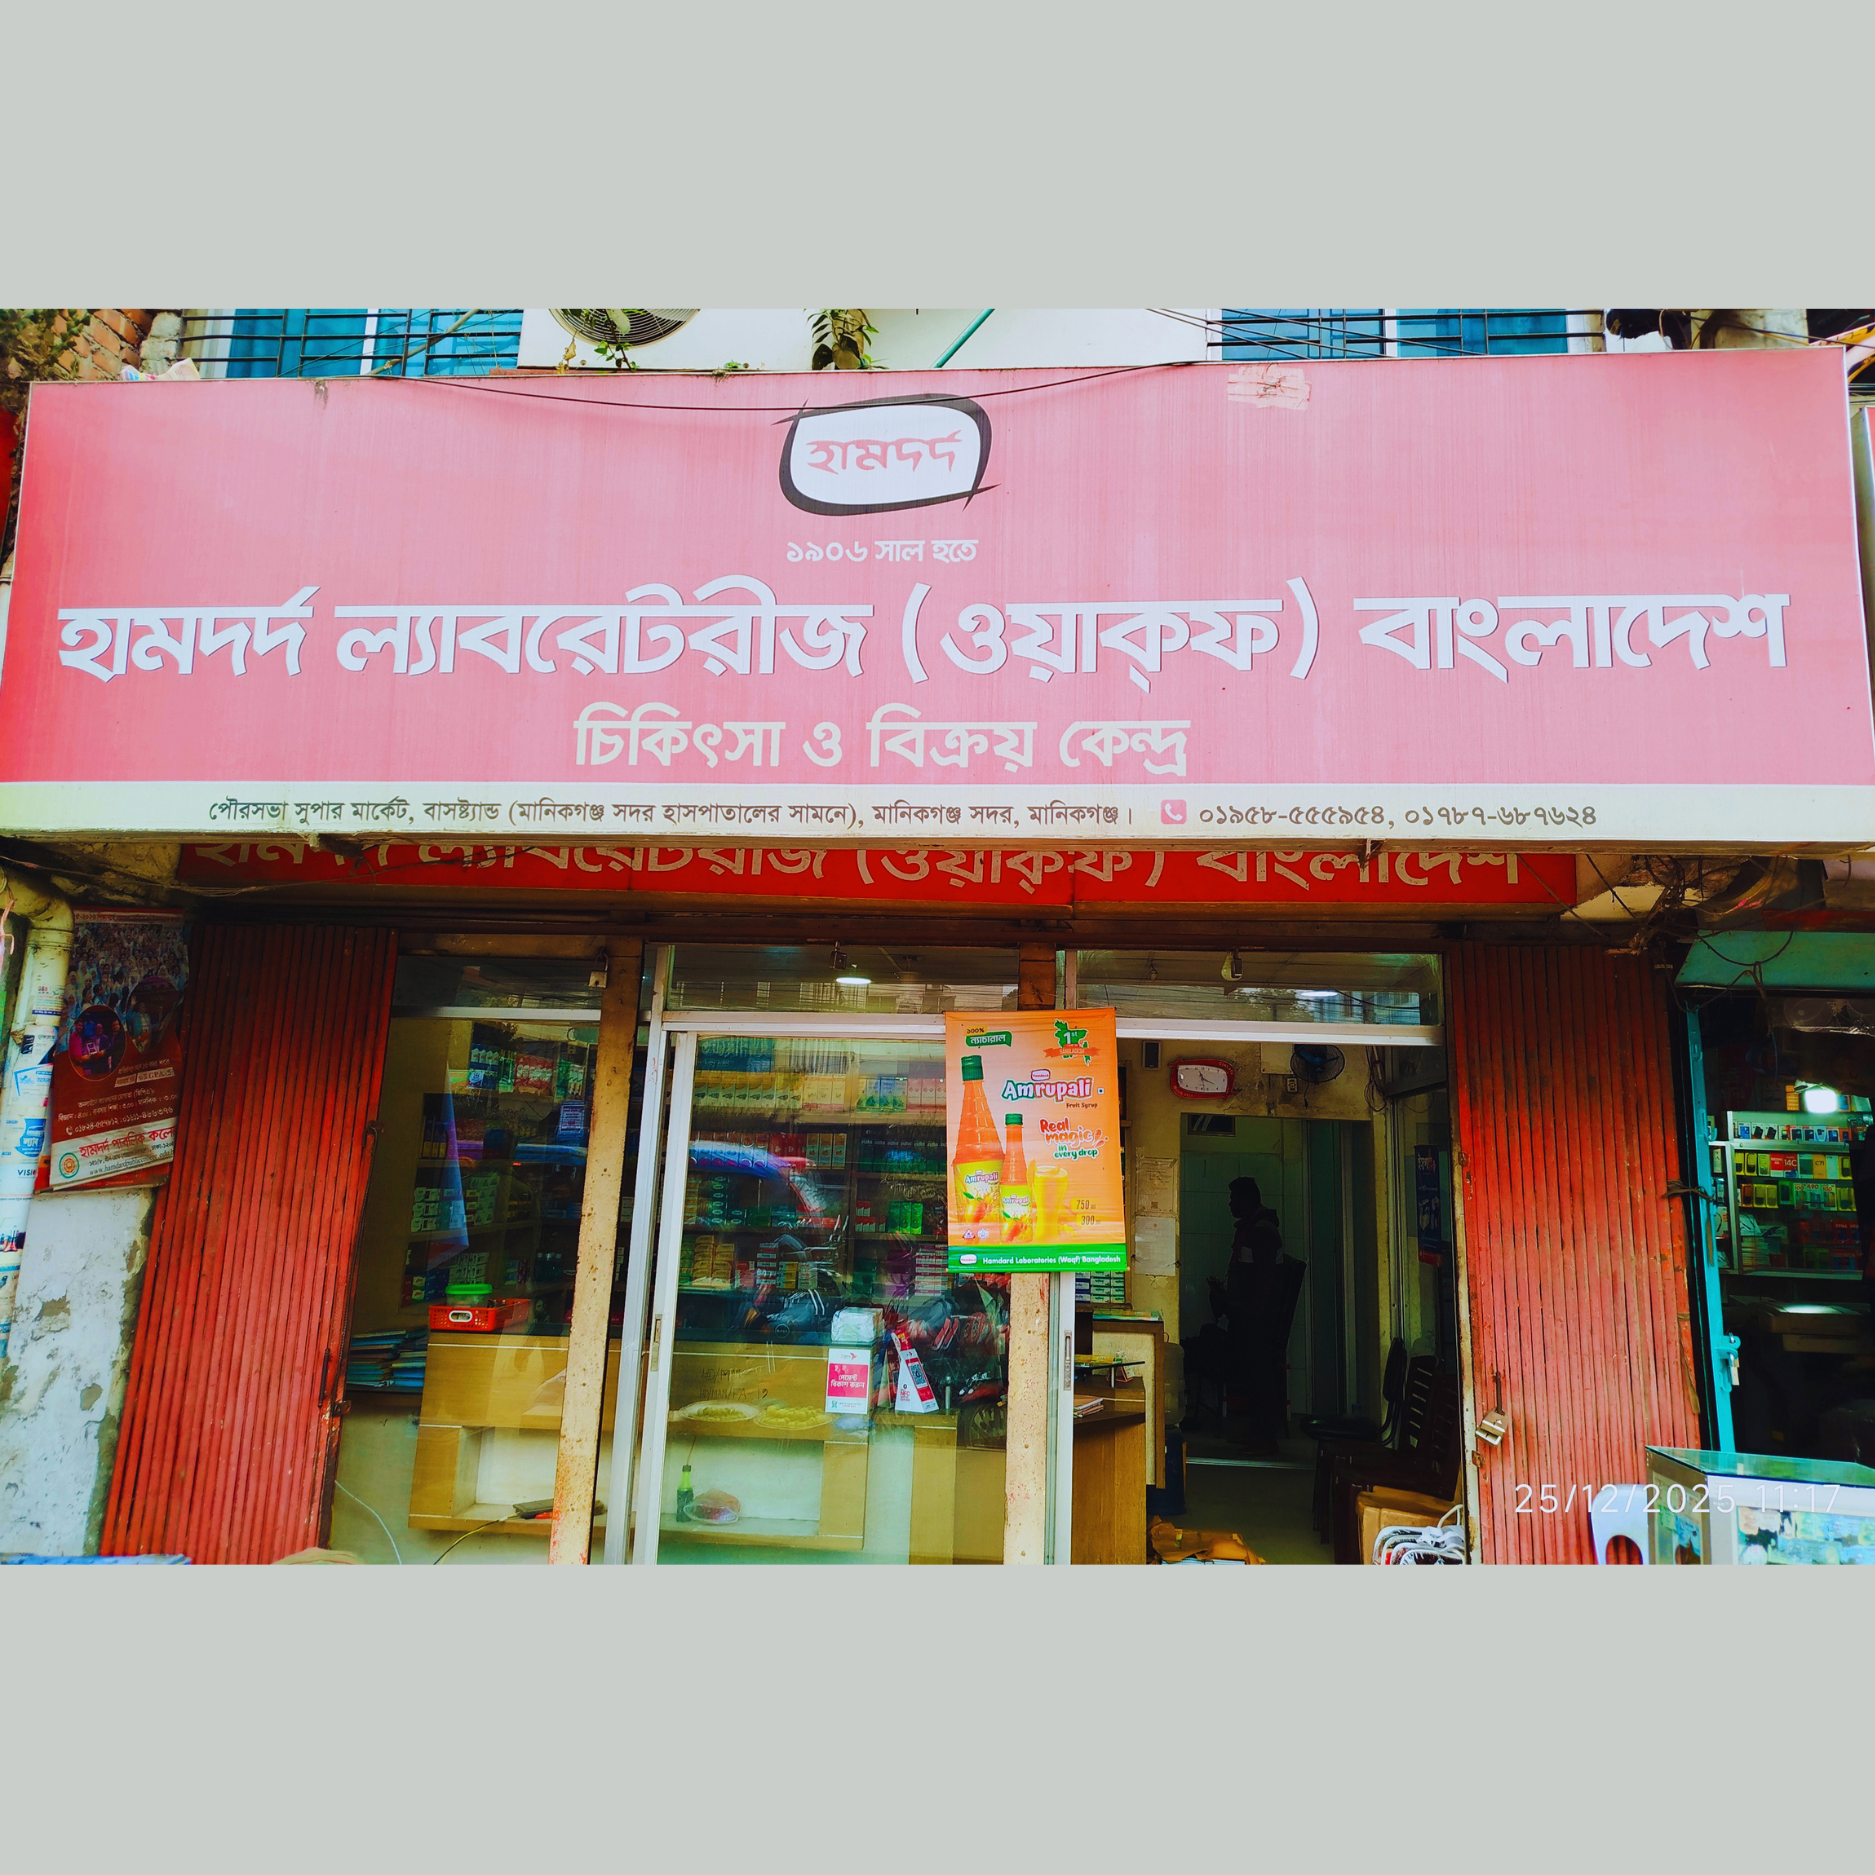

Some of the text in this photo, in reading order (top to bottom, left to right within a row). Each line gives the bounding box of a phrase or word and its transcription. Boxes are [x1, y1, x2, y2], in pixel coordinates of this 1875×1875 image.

[807, 429, 962, 475] হামদর্দ
[786, 538, 978, 563] ১৯০৬ সাল হতে
[57, 586, 321, 682] হামদর্দ
[334, 574, 874, 677] ল্যাবরেটরীজ
[1353, 593, 1790, 683] বাংলাদেশ
[573, 702, 1191, 777] চিকিৎসা ও বিক্রয় কেন্দ্র
[209, 796, 288, 822] পৌরসভা
[294, 800, 345, 824] সুপার
[350, 796, 415, 825] মার্কেট,
[508, 797, 605, 827] (মানিকগঞ্জ
[612, 803, 657, 824] সদর
[661, 803, 782, 826] হাসপাতালের
[789, 803, 864, 829] সামনে),
[871, 799, 962, 825] মানিকগঞ্জ
[968, 804, 1020, 829] সদর,
[1199, 805, 1395, 829] ০১৯৫৮-৫৫৫৯৫৪,
[1405, 805, 1598, 829] ০১৭৮৭-৬৮৭৬২৪
[970, 1033, 1007, 1045] ন্যাচারাল
[1059, 1047, 1085, 1055] BANGLADESH
[1002, 1077, 1093, 1102] Amrupali
[1040, 1117, 1070, 1133] Real
[1045, 1129, 1093, 1145] magic
[79, 1138, 110, 1159] হামদর্দ
[1058, 1142, 1068, 1151] in
[1053, 1147, 1098, 1160] every drop
[1783, 1158, 1798, 1167] 14C
[965, 1172, 998, 1184] Amrupali
[1076, 1199, 1090, 1210] 750
[1081, 1215, 1095, 1225] 300
[982, 1255, 1121, 1266] Hamdard Laboratories (Waqf) Bangladesh
[830, 1379, 849, 1388] বিকাশ
[838, 1373, 858, 1382] পেমেন্ট
